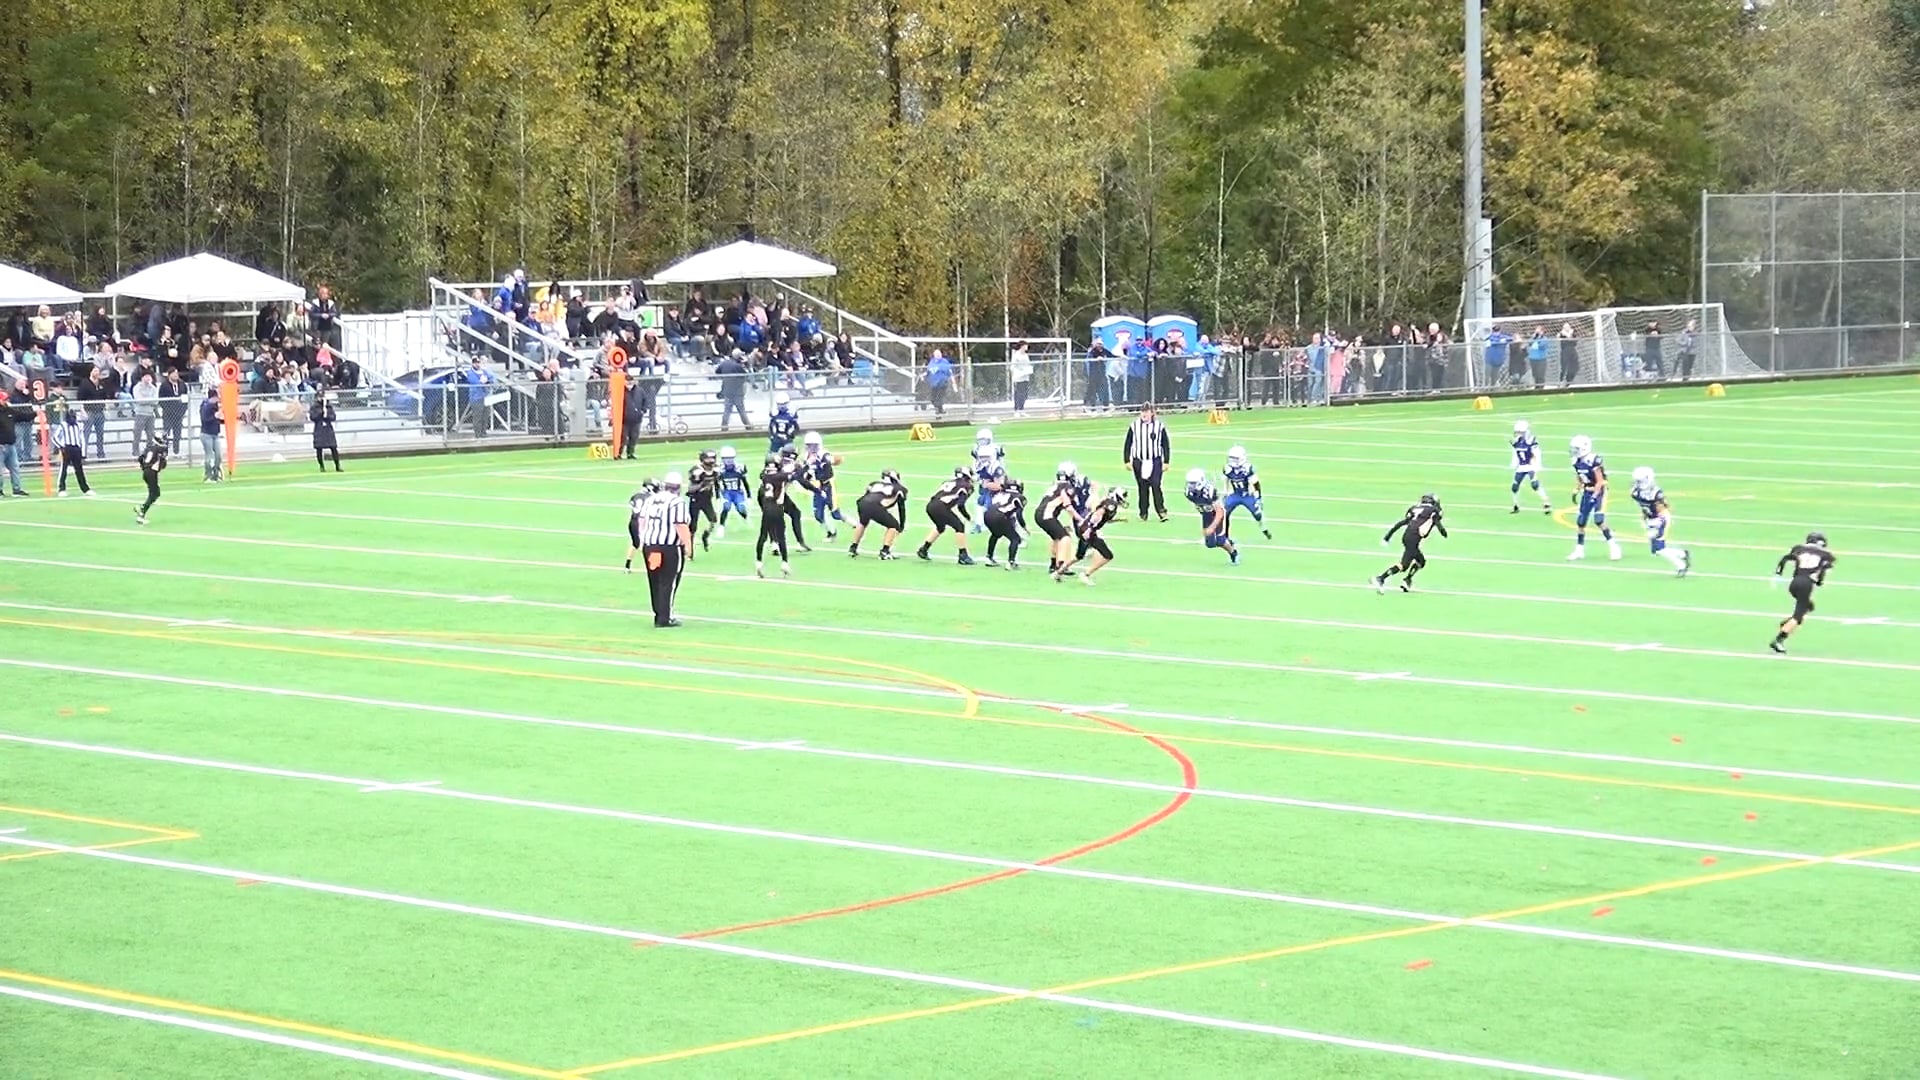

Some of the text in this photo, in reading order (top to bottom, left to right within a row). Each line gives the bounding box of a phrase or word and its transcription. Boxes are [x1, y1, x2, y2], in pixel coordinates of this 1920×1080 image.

[919, 427, 934, 439] 50
[595, 446, 608, 458] 50
[764, 483, 774, 497] 2
